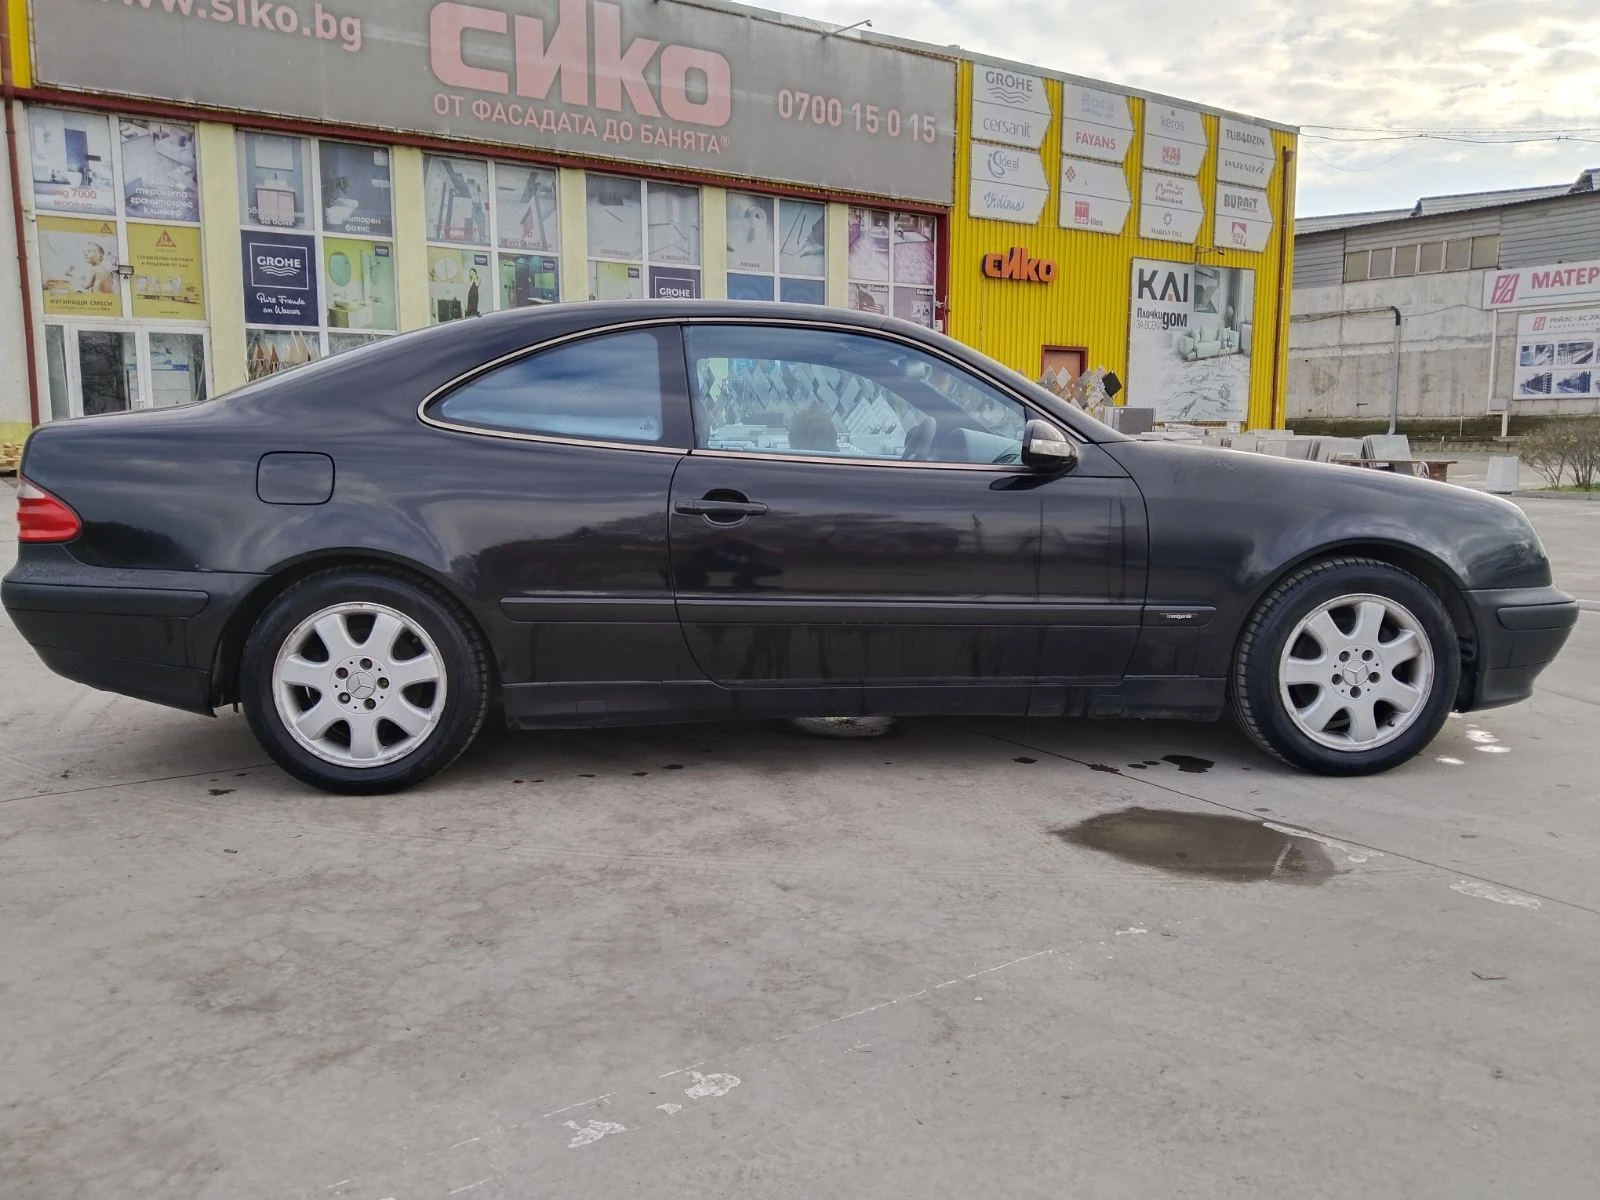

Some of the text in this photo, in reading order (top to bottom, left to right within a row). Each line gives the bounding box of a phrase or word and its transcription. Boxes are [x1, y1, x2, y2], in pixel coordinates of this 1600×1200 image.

[985, 71, 1033, 92] GROHE
[433, 93, 464, 117] ОТ
[471, 98, 598, 135] ФАСАДАТА
[602, 118, 633, 143] ДО
[778, 88, 936, 144] 0700 15 0 15
[983, 118, 1031, 138] cersanit
[1075, 131, 1116, 150] FAYANS
[256, 256, 302, 268] GROHE
[659, 287, 691, 297] GROHE
[1138, 268, 1189, 302] KAI
